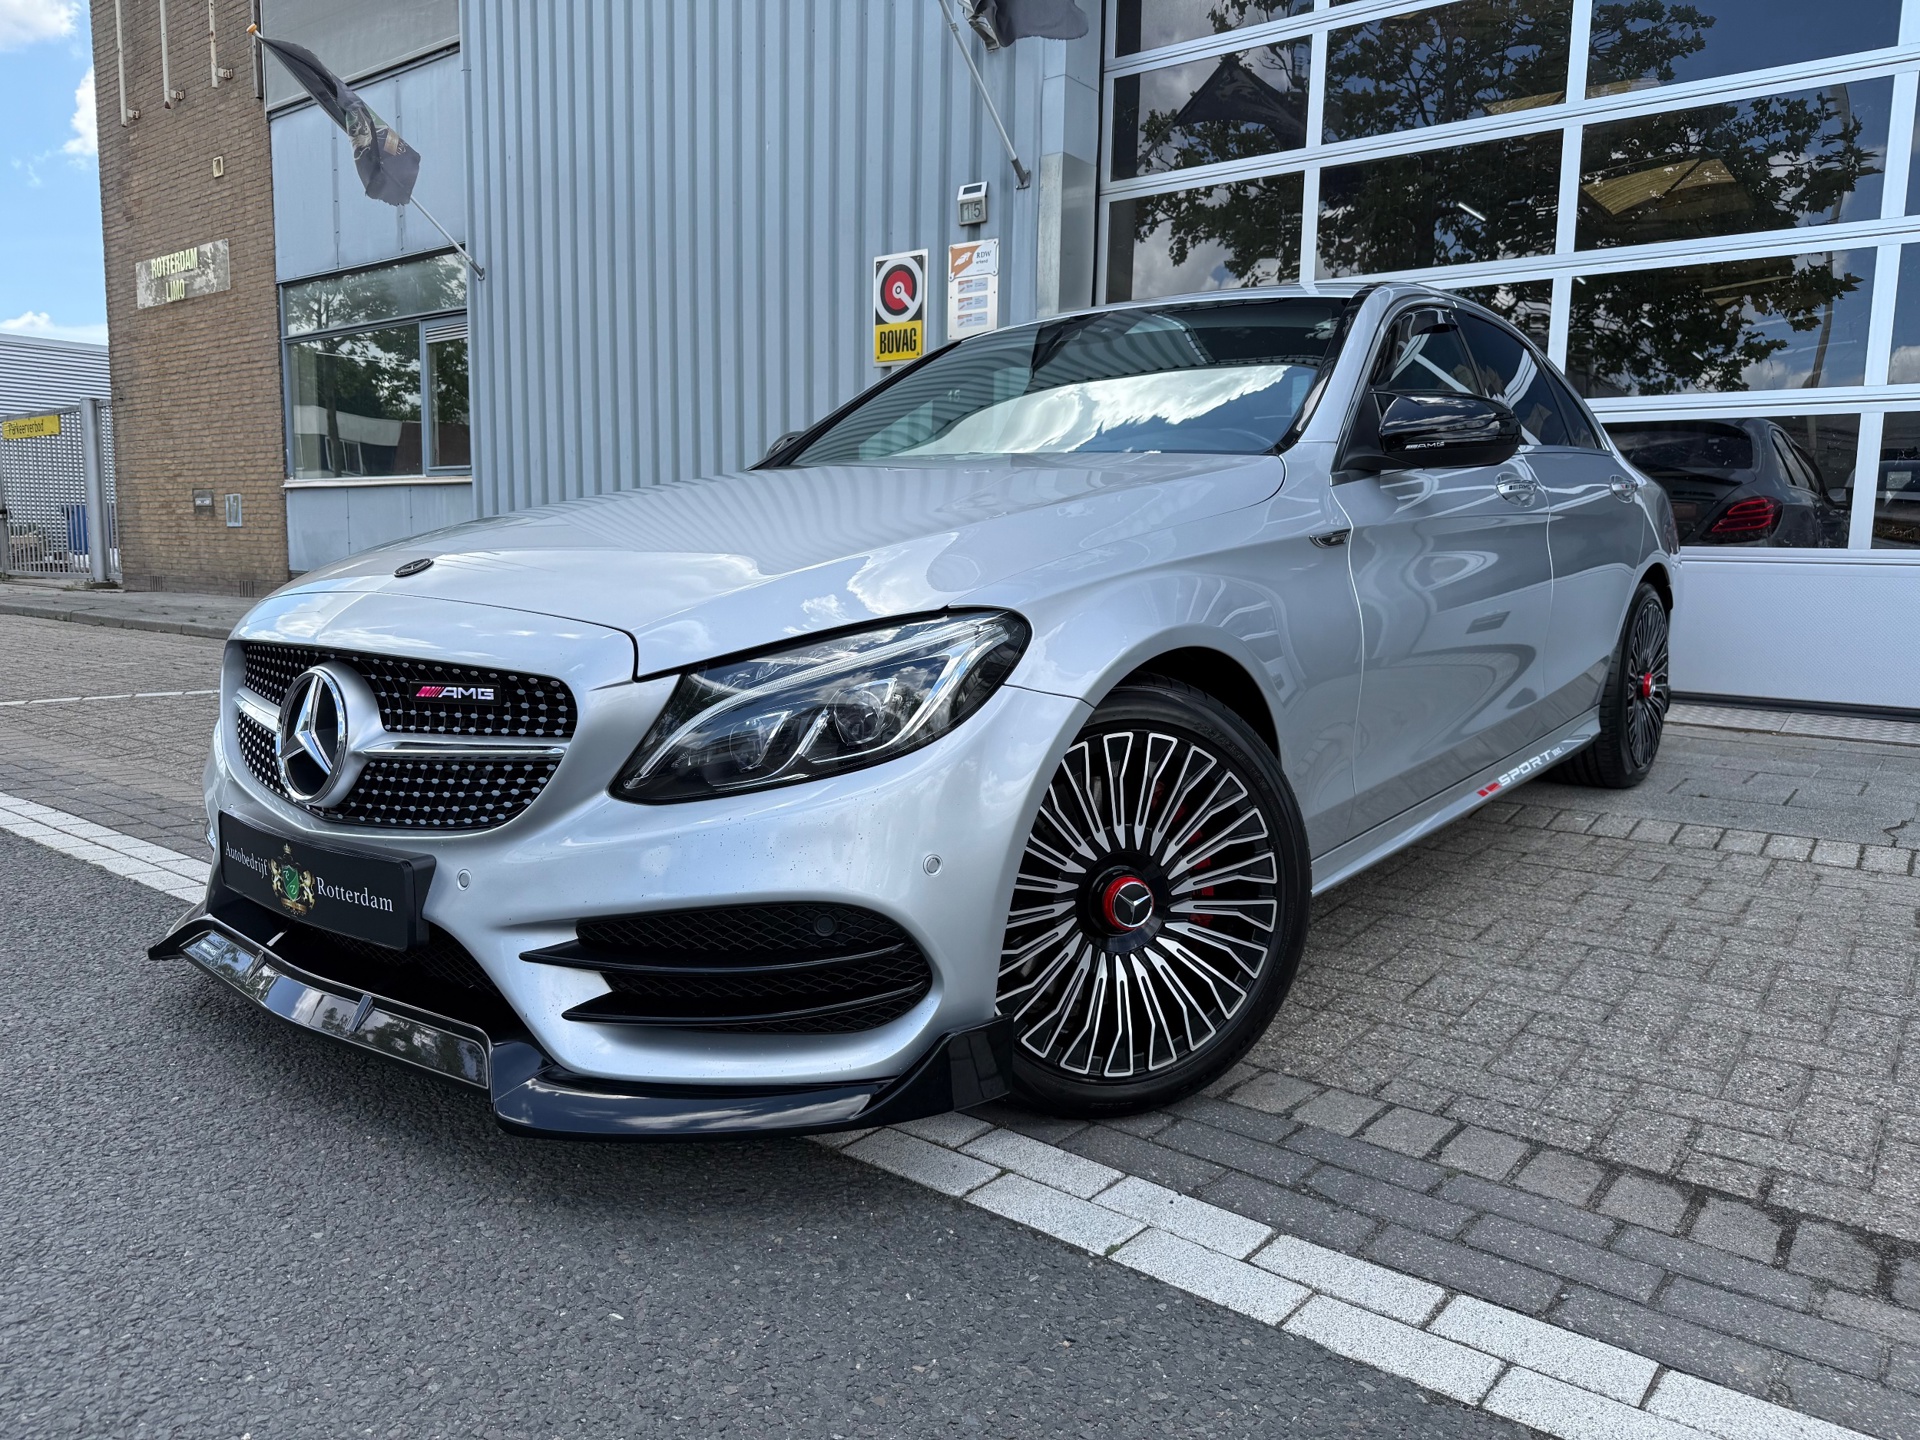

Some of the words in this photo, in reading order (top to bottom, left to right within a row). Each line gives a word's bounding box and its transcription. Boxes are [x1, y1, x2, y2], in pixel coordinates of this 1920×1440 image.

[965, 203, 981, 220] 15
[151, 247, 198, 279] ROTTERDAM
[976, 250, 992, 258] RDW
[166, 279, 186, 302] LIMO
[880, 328, 916, 354] BOVAG
[438, 686, 494, 700] AMG
[1498, 750, 1551, 786] SPORT
[225, 841, 268, 879] Autobedrijf
[316, 876, 394, 912] Rotterdam
